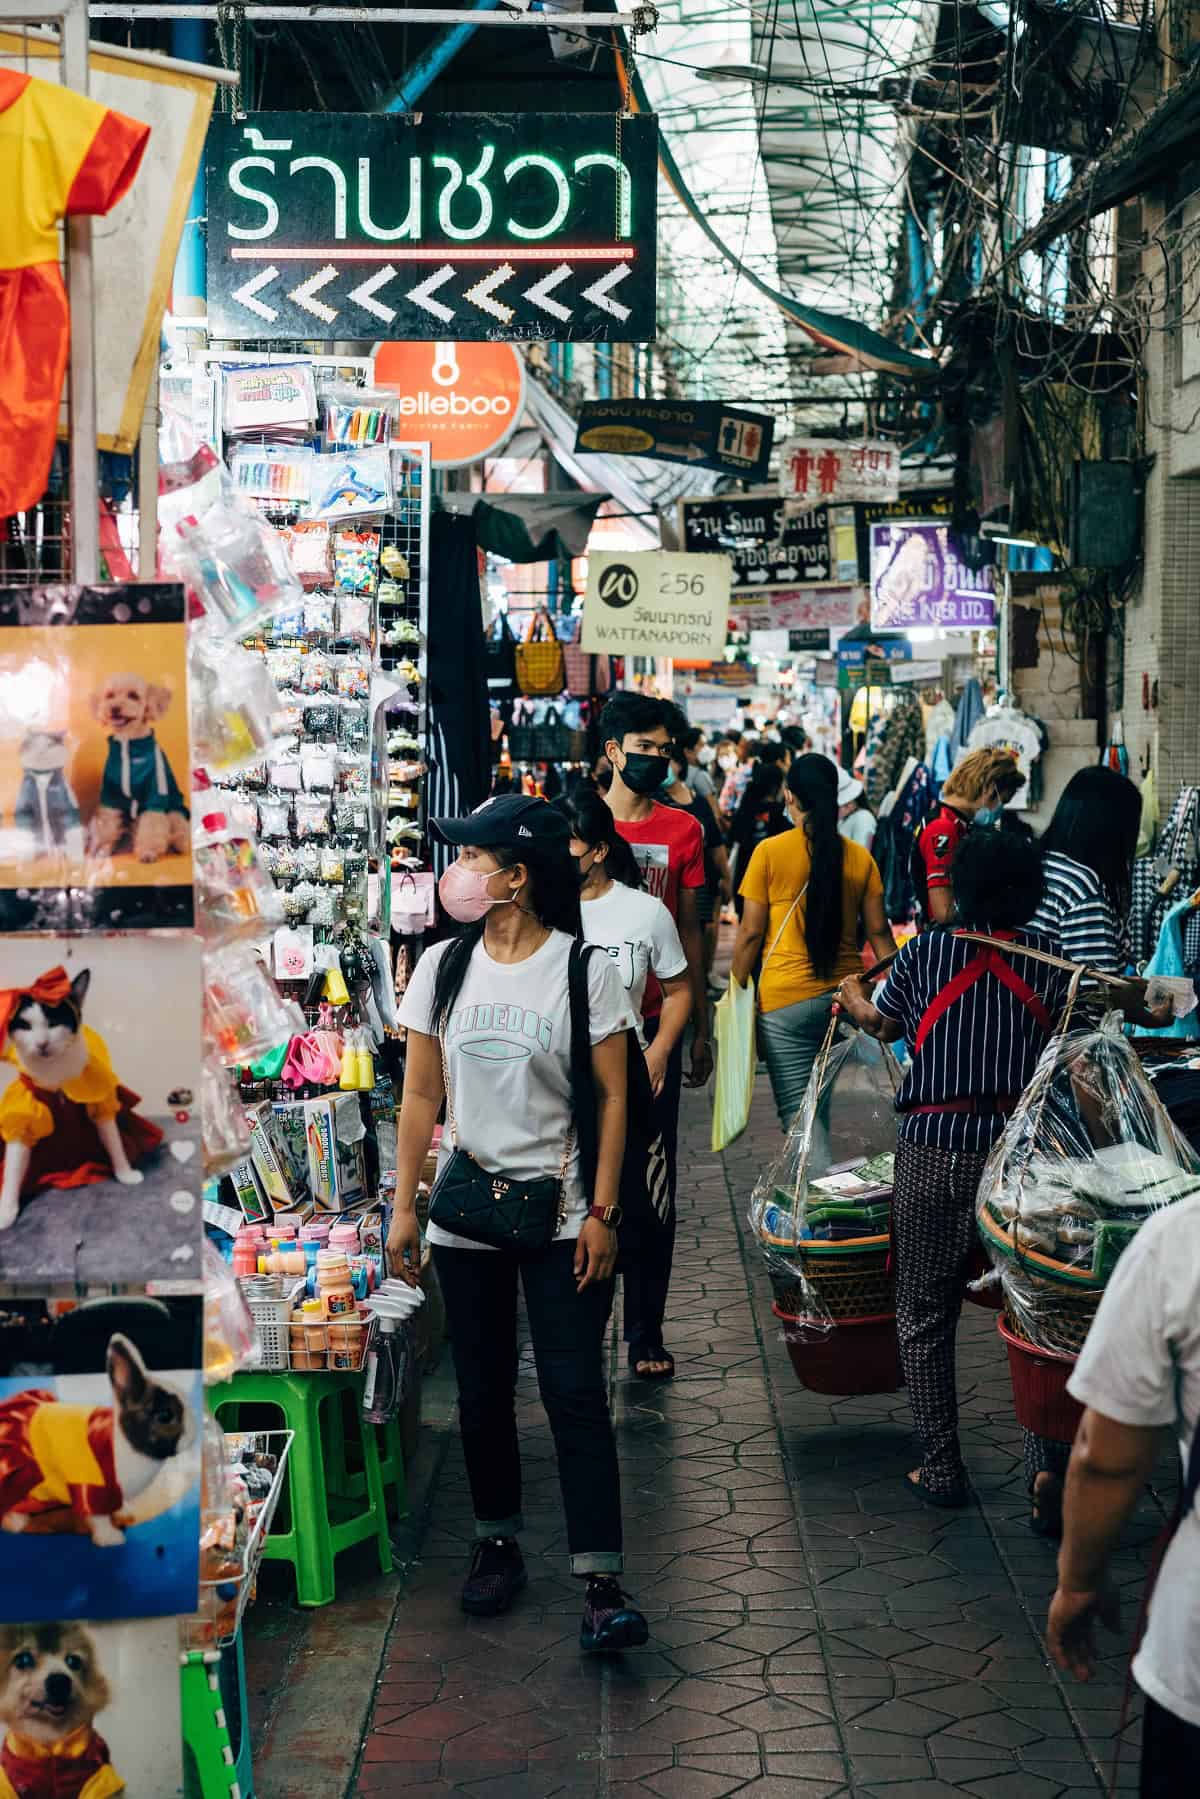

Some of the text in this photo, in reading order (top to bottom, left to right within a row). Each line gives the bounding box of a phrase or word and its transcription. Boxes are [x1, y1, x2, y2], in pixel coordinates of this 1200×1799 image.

[227, 128, 632, 240] ร้านชวา
[400, 391, 510, 415] elleboo
[728, 511, 766, 534] Sun
[660, 572, 704, 595] 256
[595, 626, 713, 646] WATTANAPORN
[937, 835, 949, 848] 7
[492, 1179, 510, 1191] LYN
